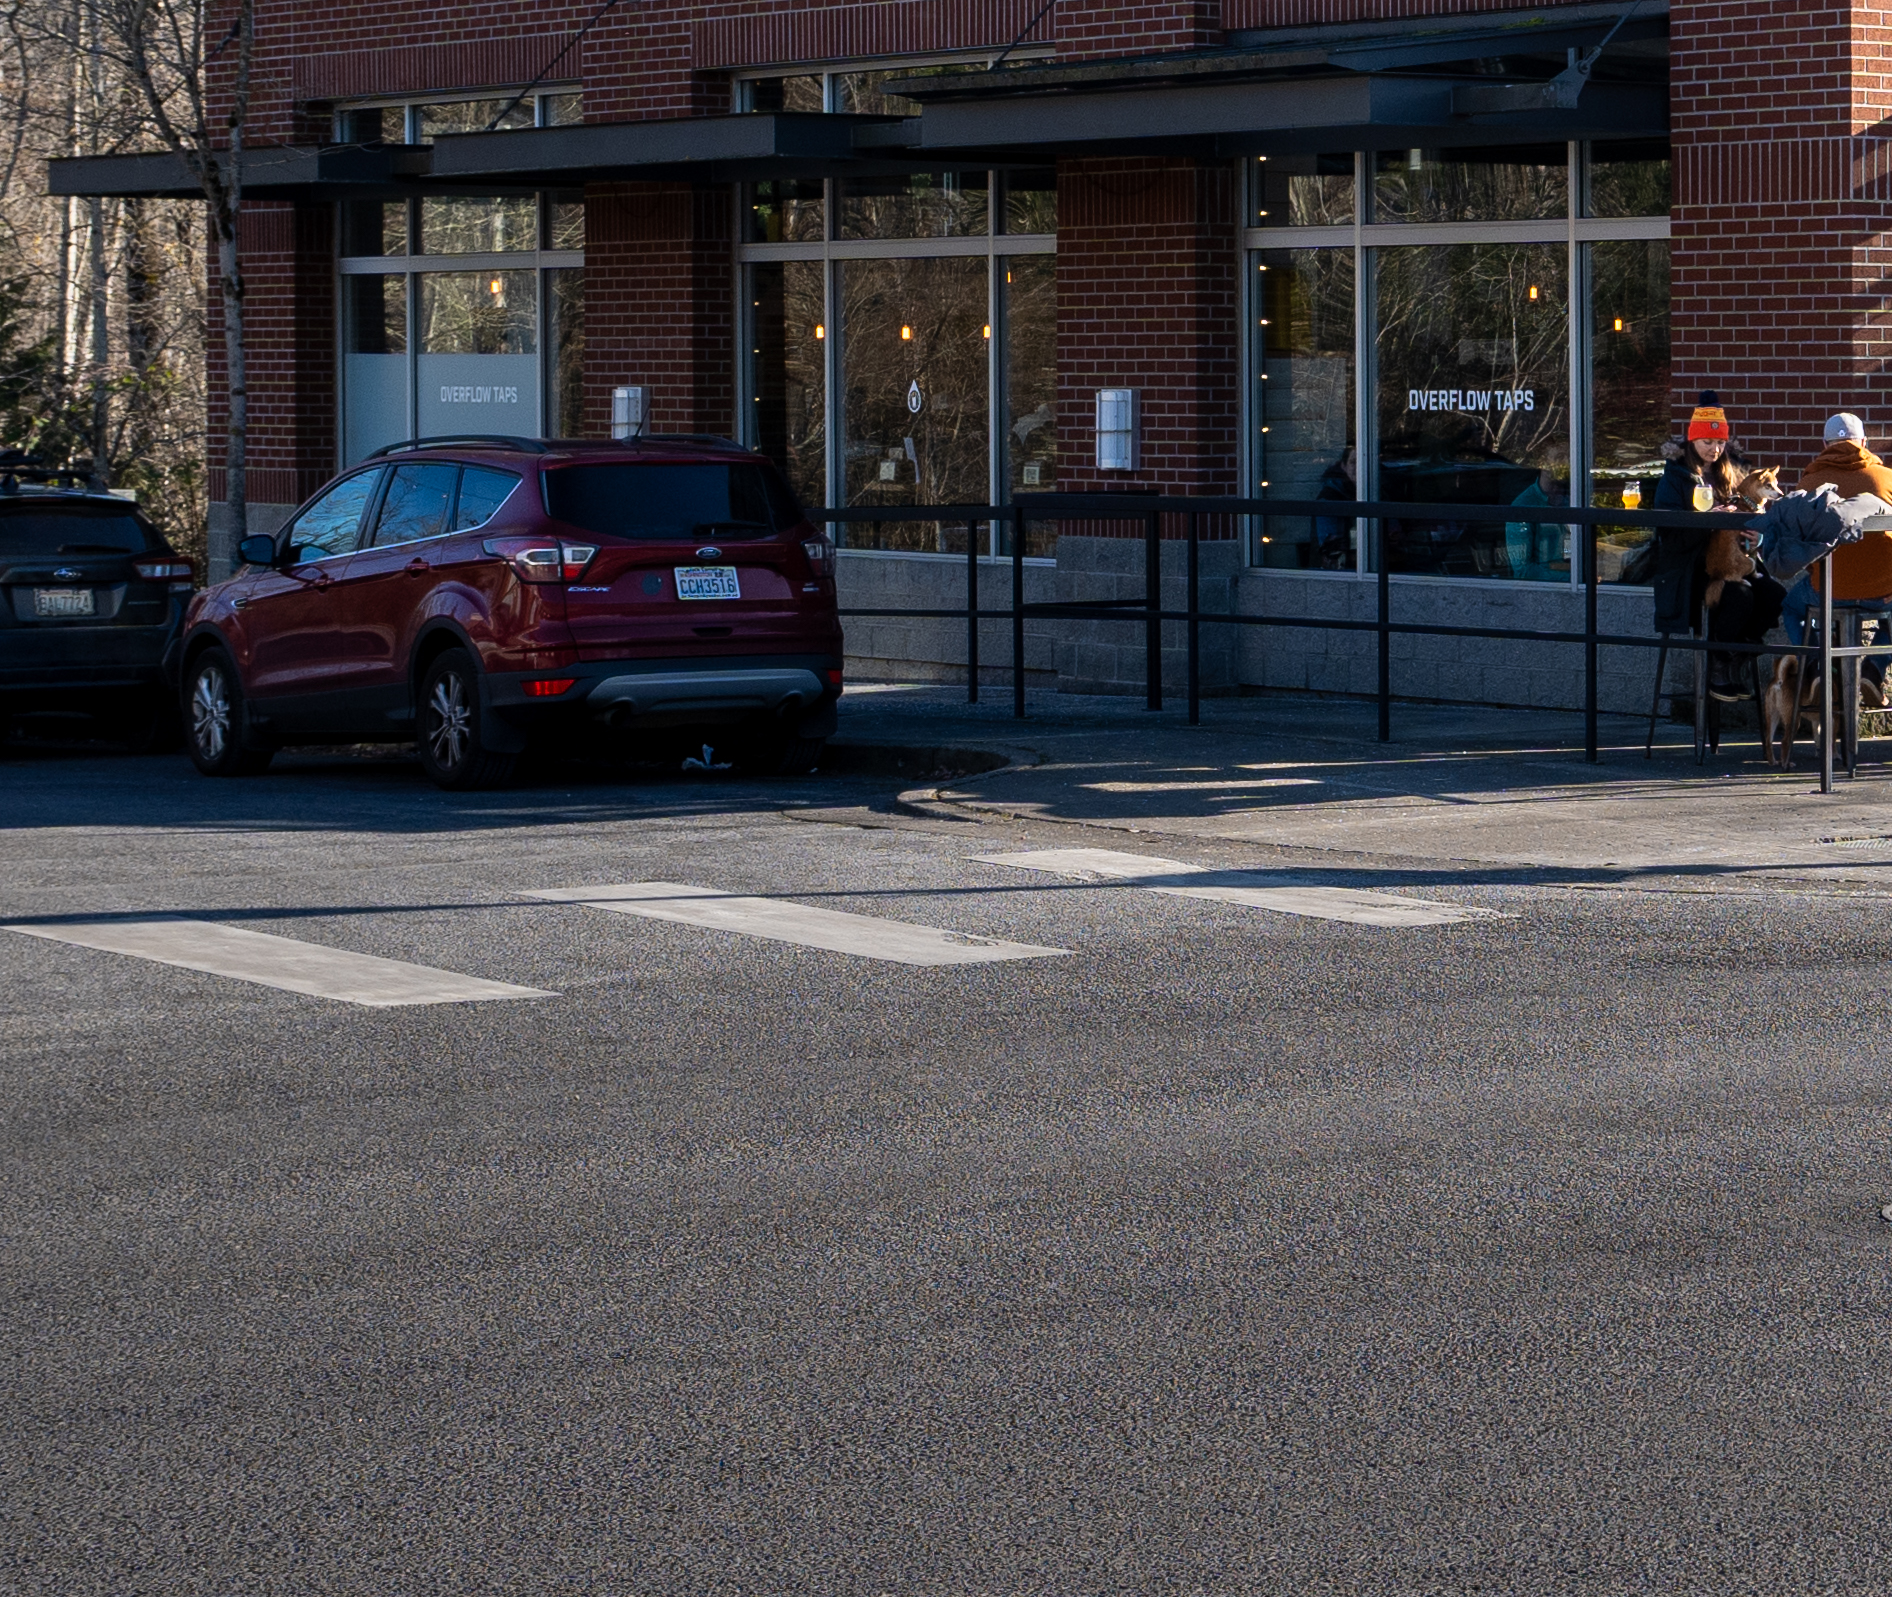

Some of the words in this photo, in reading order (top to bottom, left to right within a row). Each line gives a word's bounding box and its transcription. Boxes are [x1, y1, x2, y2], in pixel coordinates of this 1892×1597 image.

[440, 385, 492, 403] OVERFLOW
[493, 386, 518, 403] TAPS
[1408, 389, 1491, 411] OVERFLOW
[1494, 389, 1535, 411] TAPS
[680, 578, 735, 594] CCH3516
